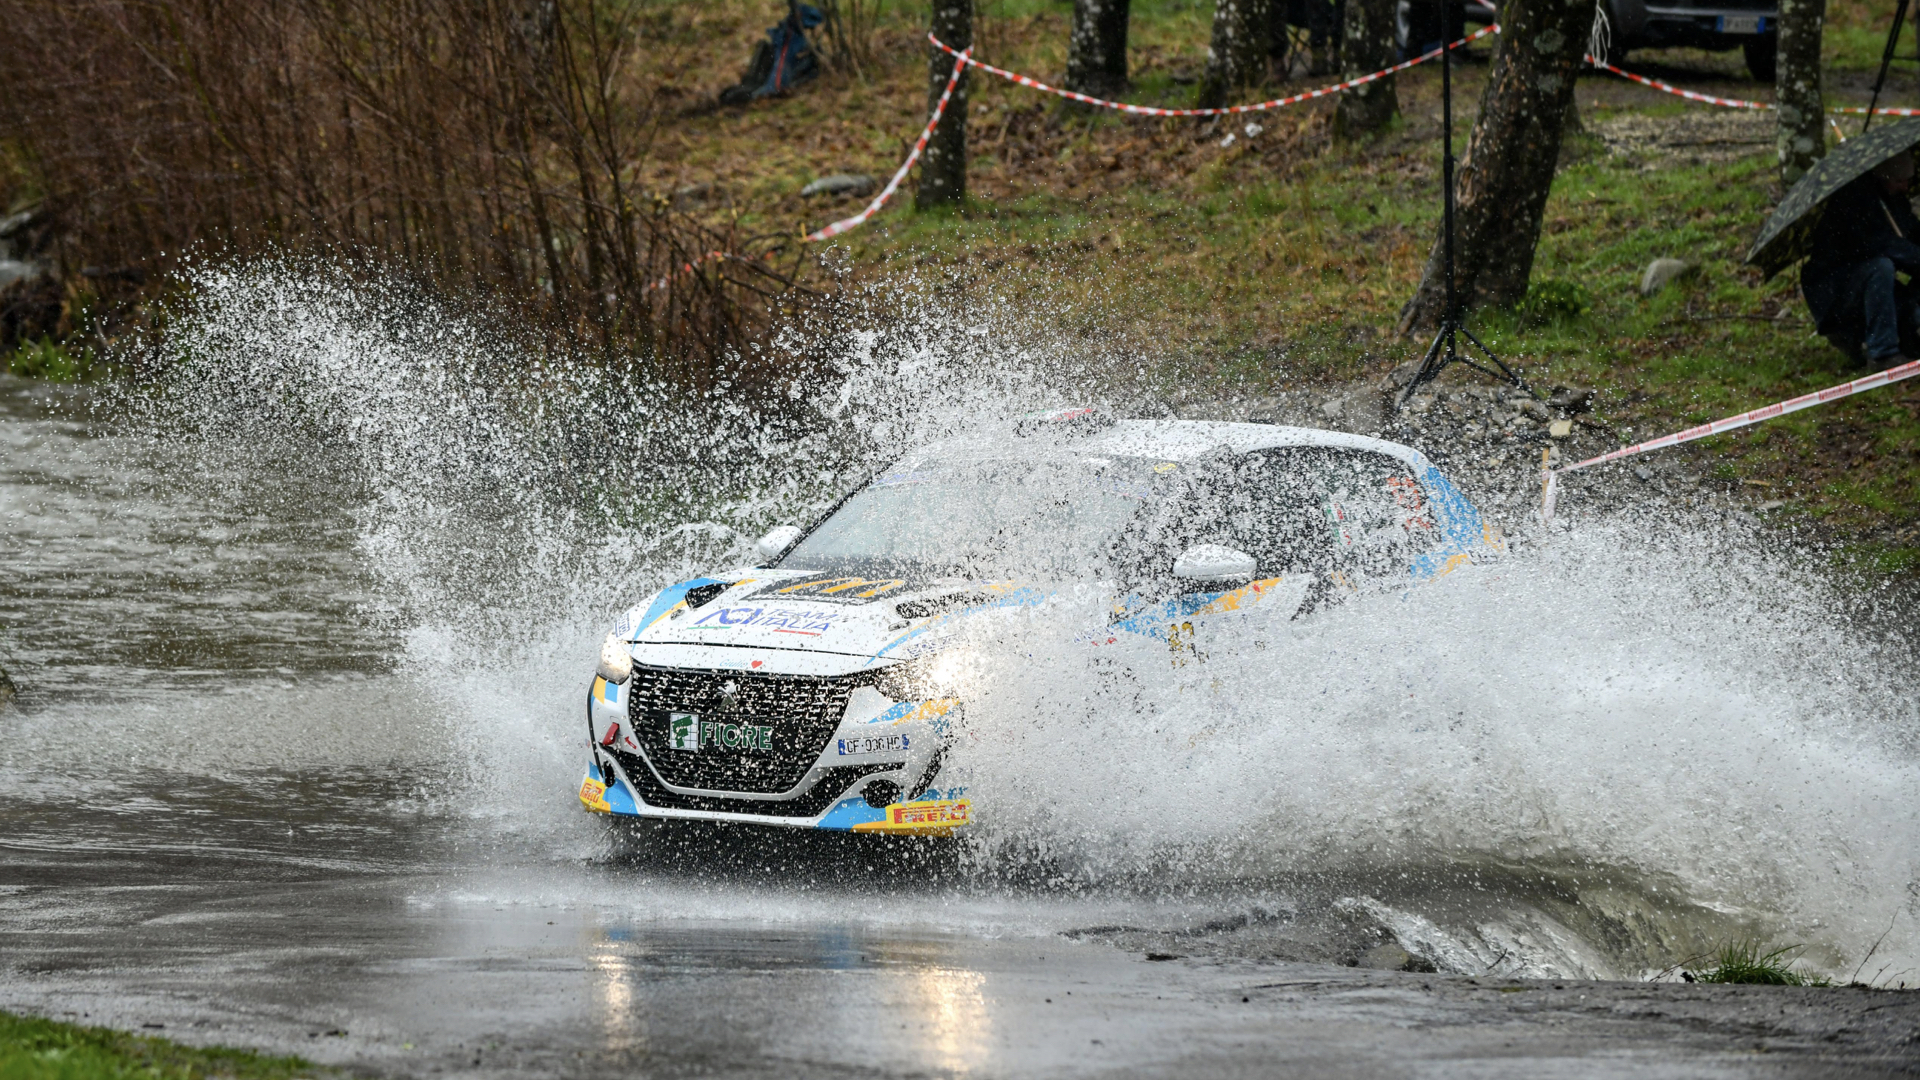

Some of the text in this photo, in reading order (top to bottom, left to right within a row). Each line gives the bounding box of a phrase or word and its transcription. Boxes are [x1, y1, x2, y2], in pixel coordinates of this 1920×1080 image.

[767, 608, 838, 620] TEAM
[751, 616, 830, 632] ITALIA
[700, 721, 773, 750] FIORE
